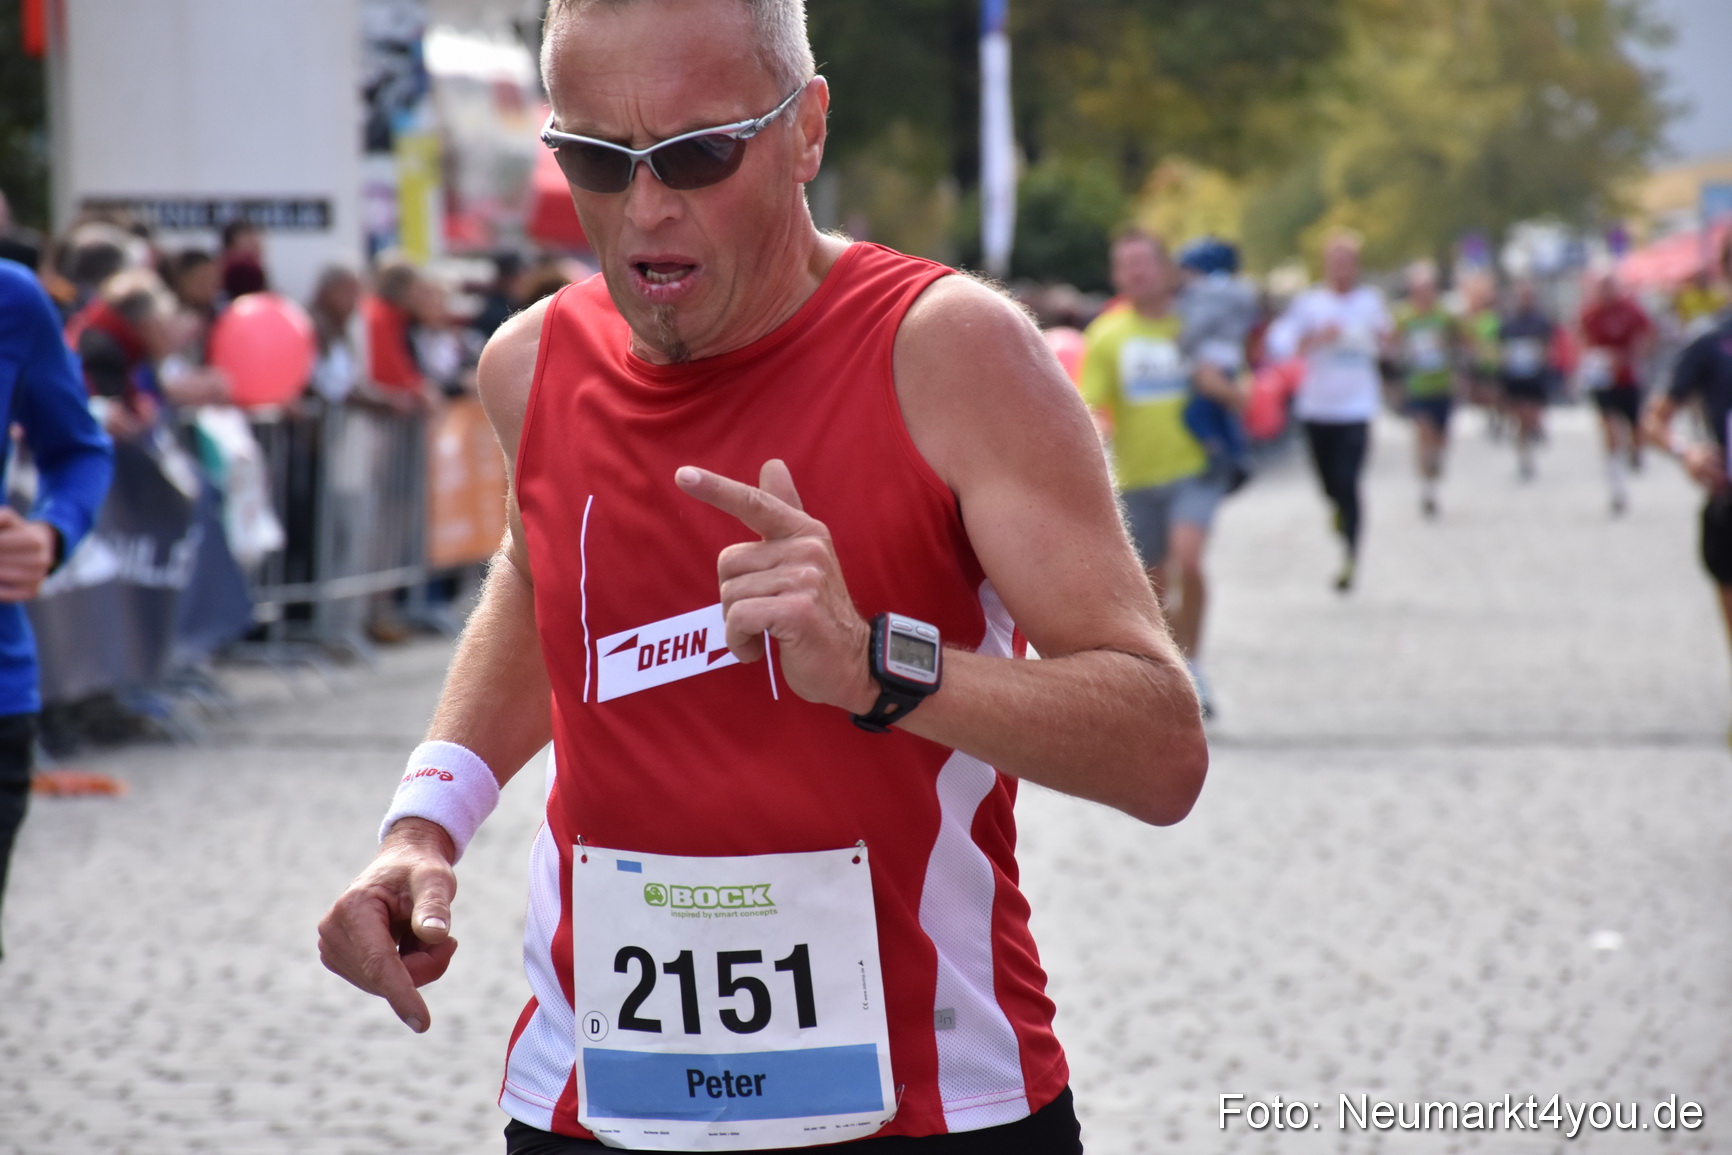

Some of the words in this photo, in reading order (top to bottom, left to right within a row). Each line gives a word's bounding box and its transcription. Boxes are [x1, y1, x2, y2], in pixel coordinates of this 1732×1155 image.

[638, 627, 708, 672] DEHN
[670, 883, 775, 909] BOCK
[671, 910, 700, 919] inspired
[702, 911, 713, 919] by
[714, 910, 738, 918] smart
[741, 908, 778, 918] concepts
[613, 943, 818, 1035] 2151
[591, 1018, 600, 1034] D
[686, 1068, 766, 1099] Peter
